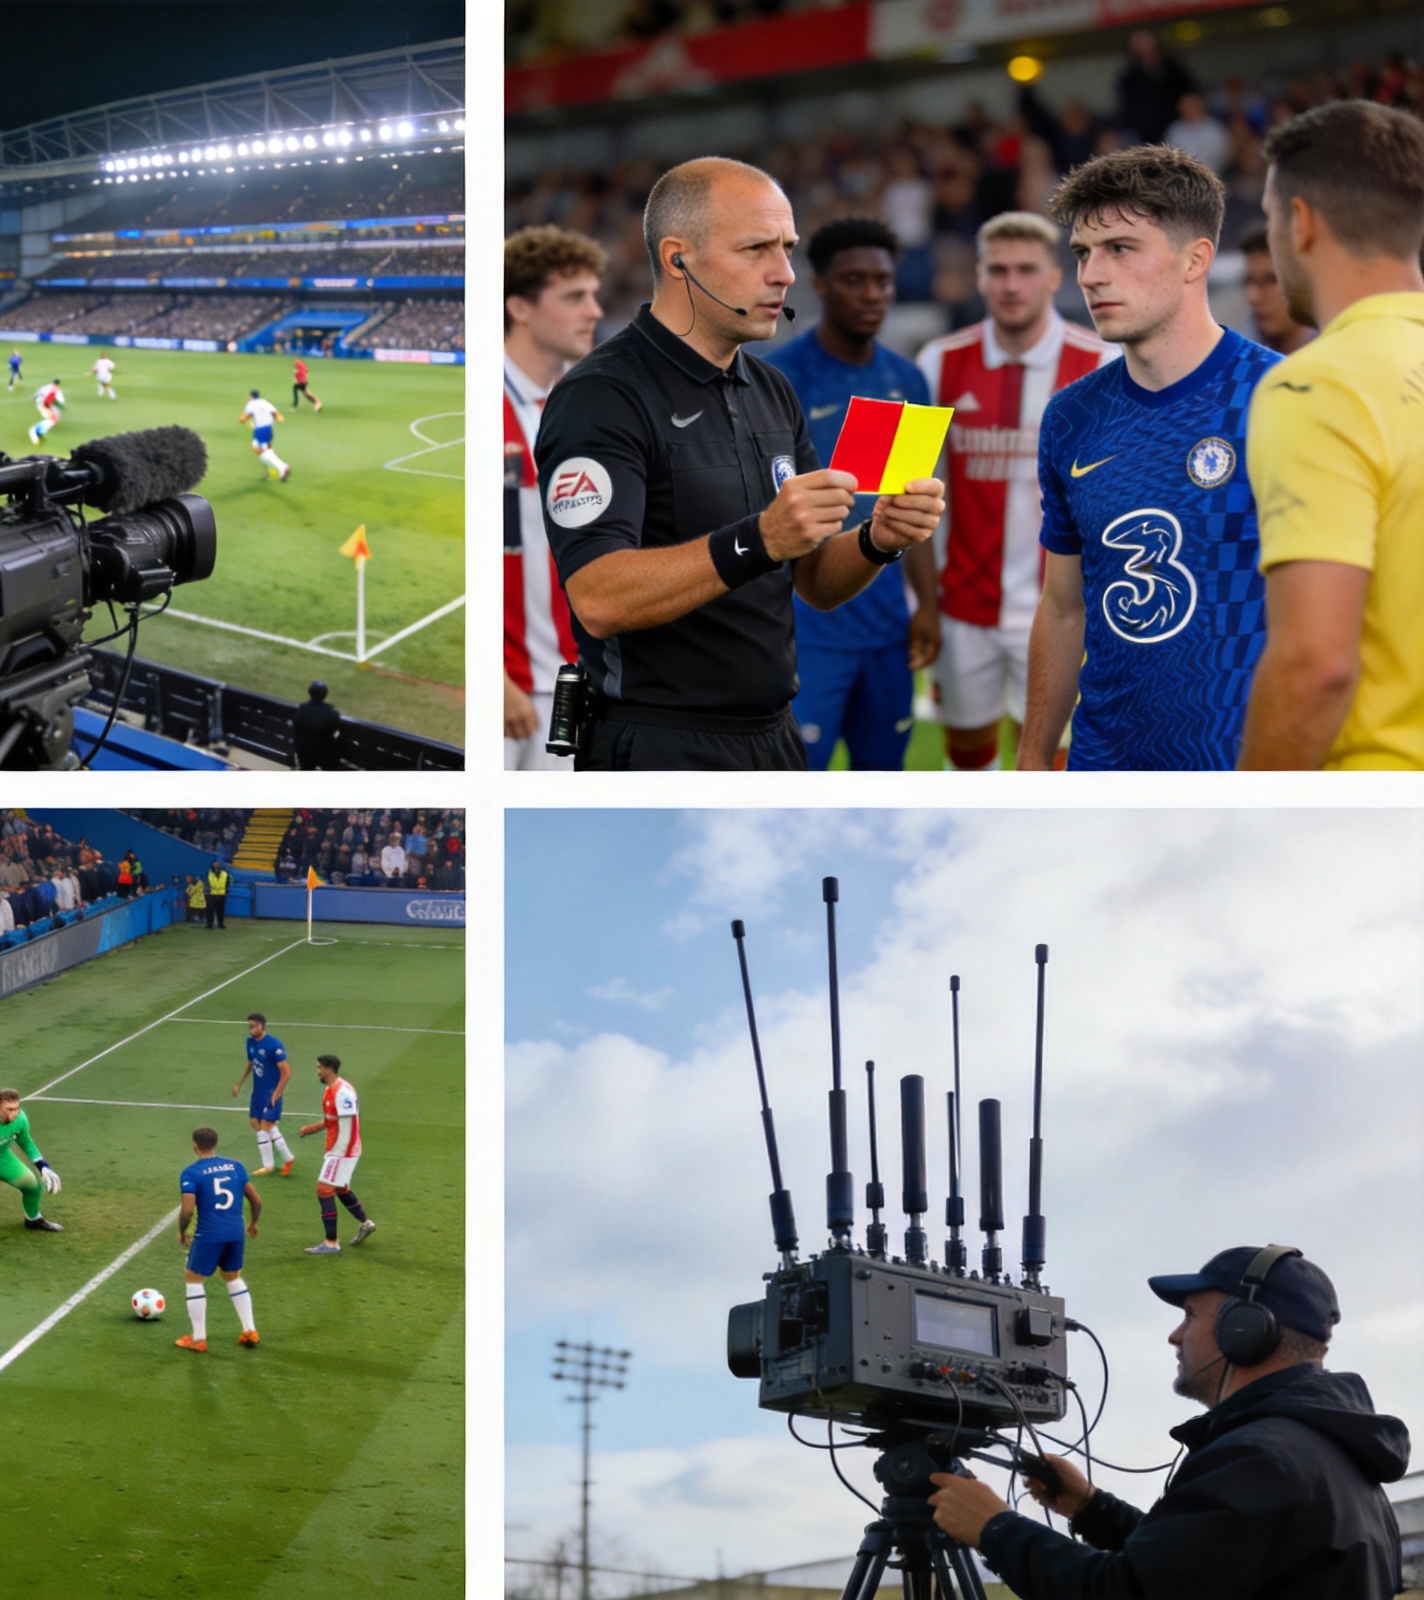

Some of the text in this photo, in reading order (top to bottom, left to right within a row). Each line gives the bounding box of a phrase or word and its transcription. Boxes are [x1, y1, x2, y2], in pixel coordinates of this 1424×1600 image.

[553, 470, 599, 503] EA
[1102, 507, 1198, 644] 3
[213, 1175, 234, 1210] 5
